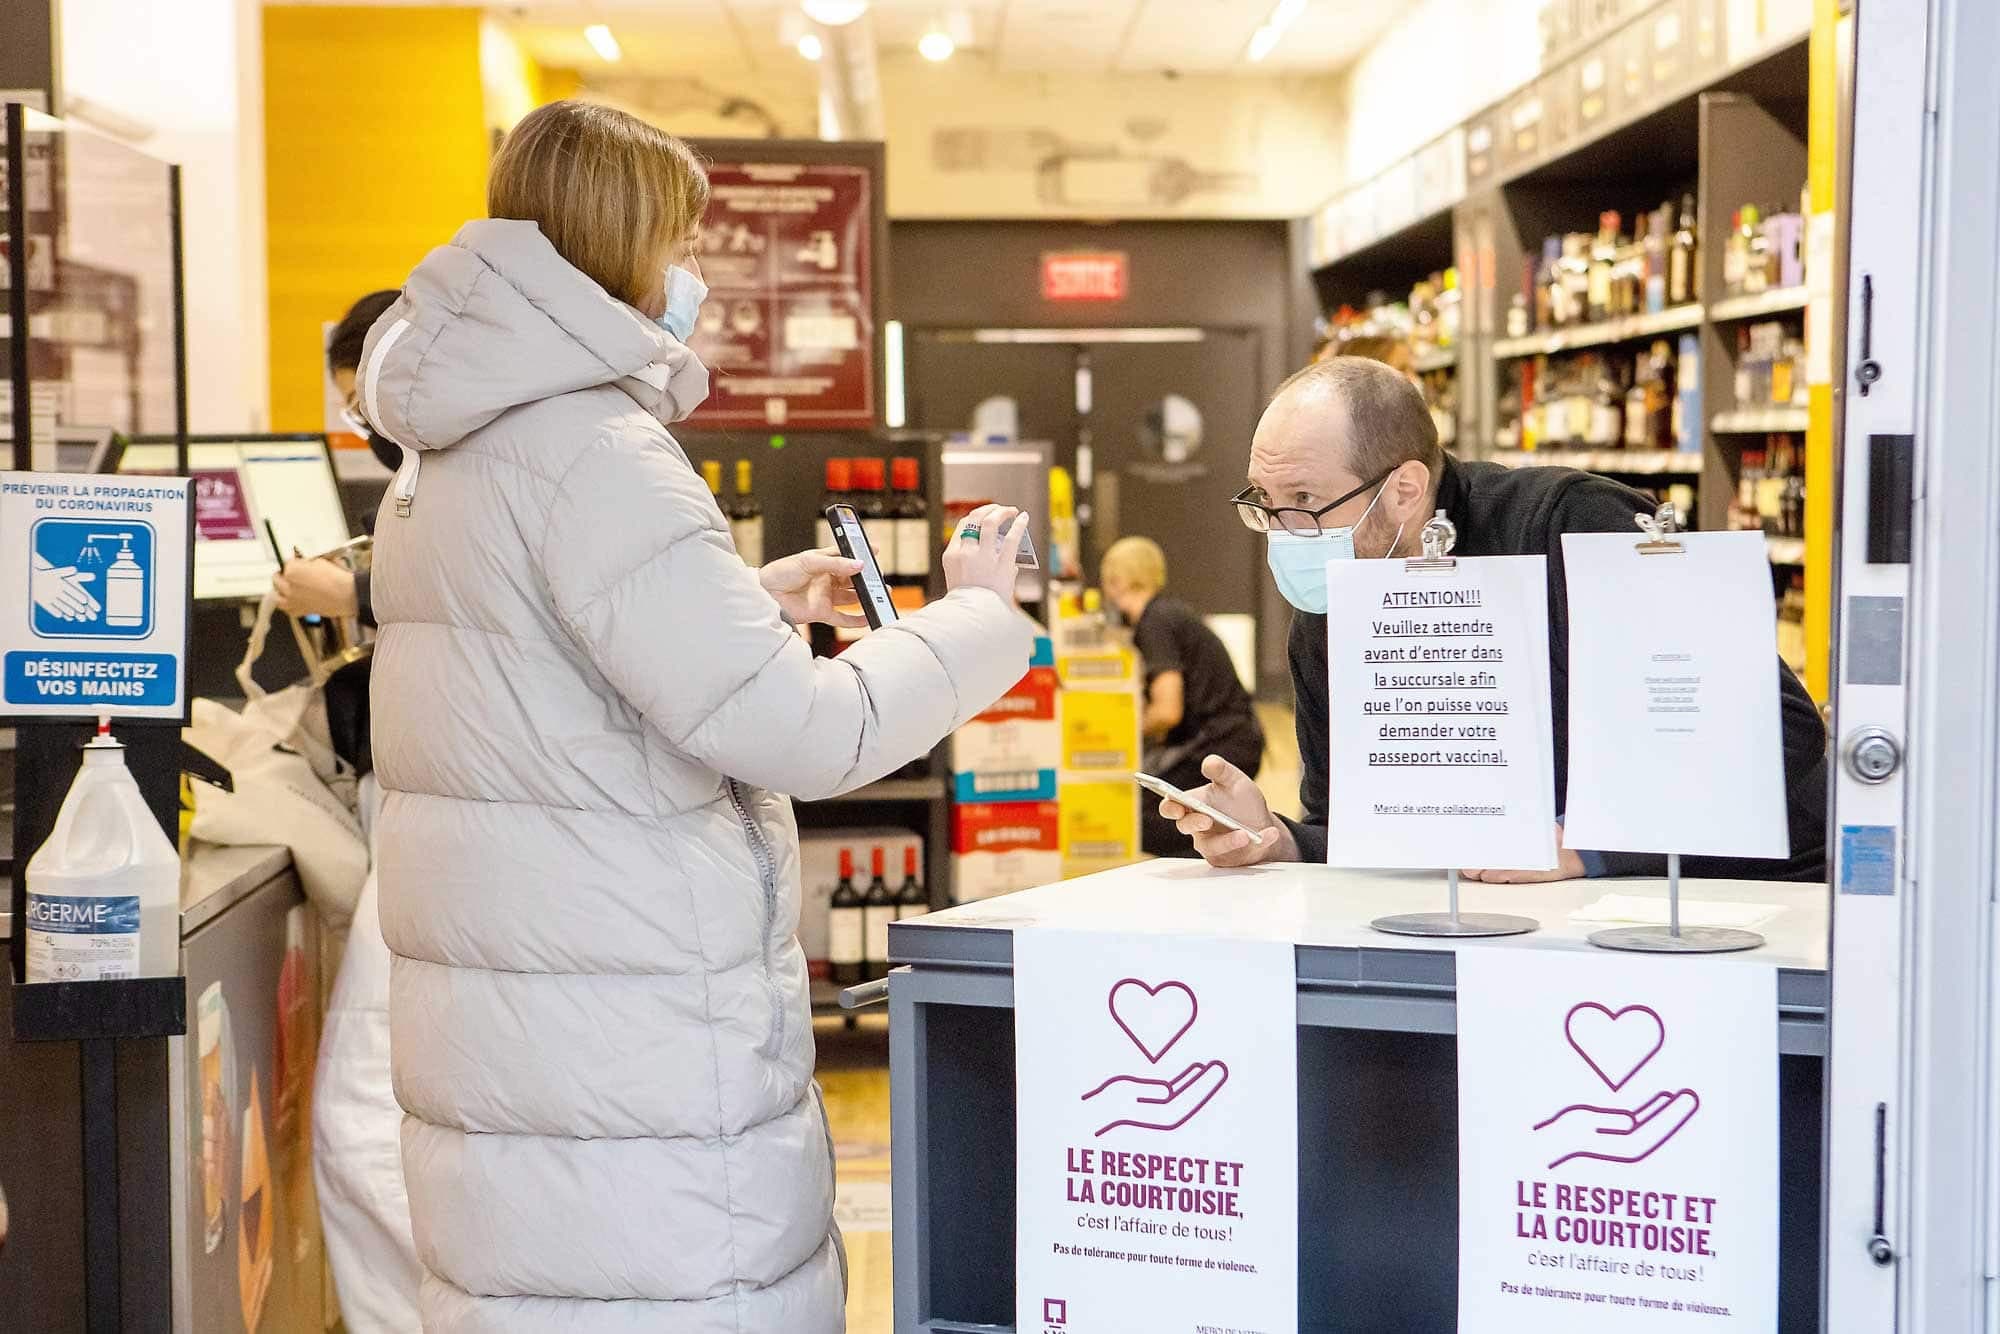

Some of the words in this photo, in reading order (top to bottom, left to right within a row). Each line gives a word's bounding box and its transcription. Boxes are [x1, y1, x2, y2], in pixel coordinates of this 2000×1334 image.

[2, 481, 69, 496] PRÉVENIR
[74, 486, 90, 497] LA
[94, 487, 185, 500] PROPAGATION
[35, 498, 54, 509] DU
[58, 499, 153, 512] CORONAVIRUS
[1382, 589, 1482, 607] ATTENTION!!!
[1372, 620, 1429, 635] Veuillez
[1433, 619, 1493, 634] attendre
[1364, 647, 1405, 661] avant
[1409, 645, 1467, 660] d’entrer
[1471, 644, 1503, 660] dans
[24, 658, 159, 679] DÉSINFECTEZ
[1374, 672, 1387, 687] la
[1391, 672, 1465, 687] succursale
[1470, 671, 1496, 686] afin
[36, 680, 77, 696] VOS
[81, 681, 145, 697] MAINS
[1363, 700, 1391, 715] que
[1395, 697, 1423, 712] l’on
[1427, 698, 1472, 714] puisse
[1475, 700, 1509, 713] vous
[1379, 723, 1454, 738] demander
[1458, 724, 1497, 738] votre
[1368, 751, 1441, 767] passeport
[1446, 749, 1509, 765] vaccinal.
[1374, 804, 1400, 814] Merci
[1403, 804, 1414, 814] de
[1416, 804, 1440, 814] votre
[1067, 1147, 1095, 1175] LE
[1101, 1150, 1209, 1184] RESPECT
[1215, 1160, 1244, 1187] ET
[1067, 1177, 1095, 1204] LA
[1100, 1180, 1244, 1220] COURTOISIE,
[1516, 1180, 1547, 1208] LE
[1556, 1183, 1677, 1220] RESPECT
[1685, 1195, 1717, 1224] ET
[1077, 1213, 1109, 1230] c'est
[1114, 1215, 1168, 1236] l'affaire
[1172, 1221, 1190, 1238] de
[1516, 1212, 1548, 1240] LA
[1555, 1216, 1717, 1258] COURTOISIE,
[1053, 1242, 1070, 1255] Pas
[1071, 1244, 1082, 1256] de
[1084, 1246, 1126, 1261] tolérance
[1127, 1251, 1148, 1264] pour
[1149, 1253, 1174, 1266] toute
[1175, 1256, 1203, 1268] forme
[1204, 1258, 1216, 1270] de
[1217, 1260, 1258, 1273] violence.
[1634, 1259, 1655, 1277] de
[1500, 1281, 1519, 1294] Pas
[1521, 1283, 1533, 1295] de
[1583, 1291, 1608, 1304] pour
[1609, 1293, 1636, 1307] toute
[1638, 1296, 1669, 1310] forme
[1671, 1299, 1683, 1312] de
[1685, 1301, 1732, 1316] violence.
